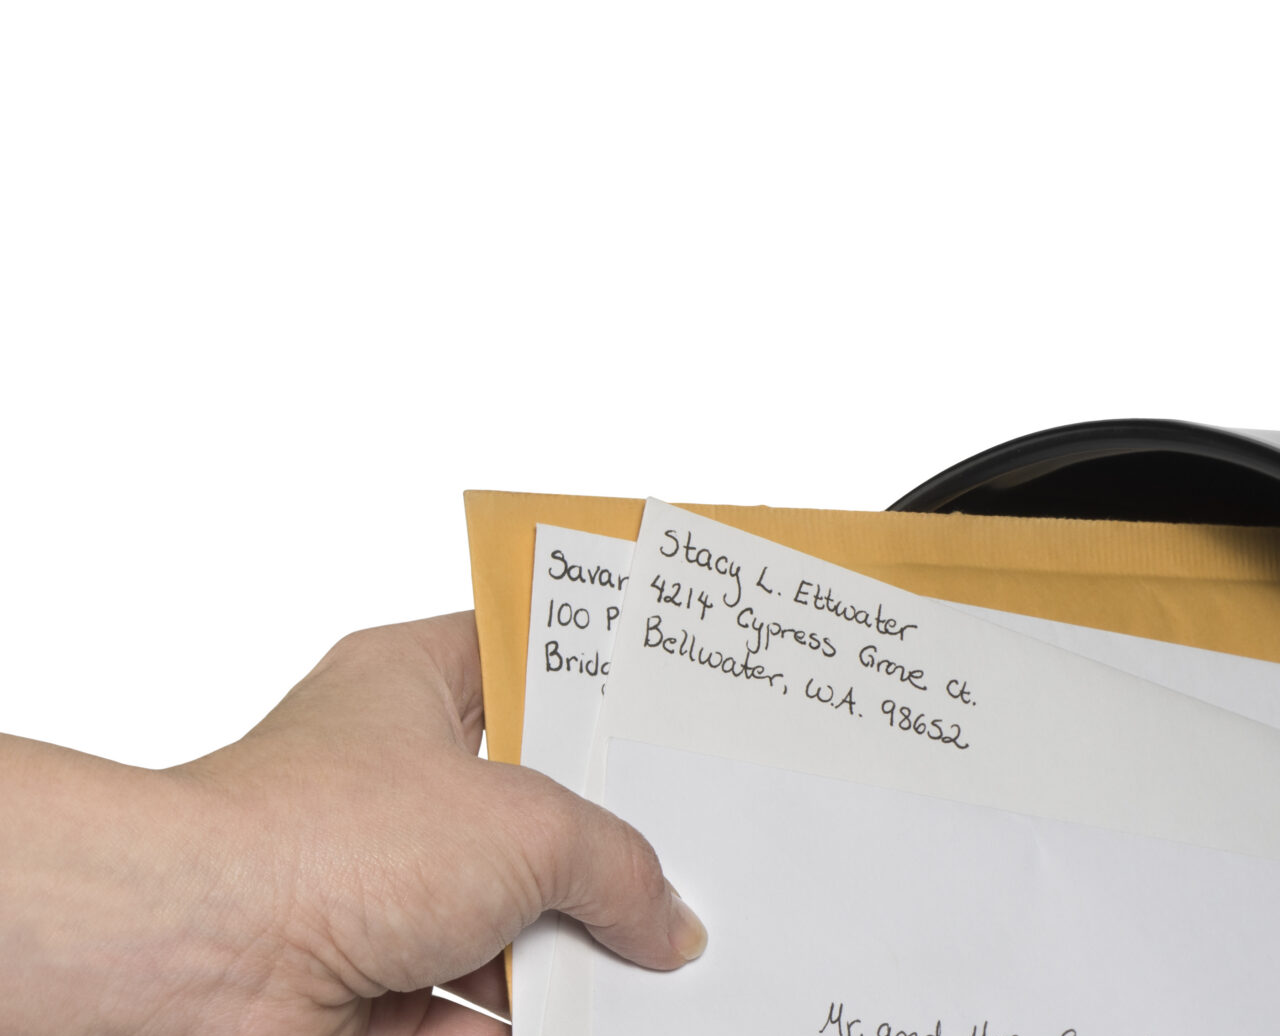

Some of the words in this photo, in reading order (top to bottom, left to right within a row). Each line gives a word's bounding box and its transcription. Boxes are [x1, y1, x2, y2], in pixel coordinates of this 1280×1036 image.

[546, 598, 591, 630] 100
[649, 574, 714, 621] 4214
[736, 607, 838, 658] Cypress
[858, 644, 928, 692] Grove
[659, 529, 743, 608] Stacy
[756, 566, 783, 597] L.
[793, 579, 919, 642] Ettwater
[643, 614, 788, 697] Bellwater,
[804, 677, 864, 718] W.A.
[880, 699, 970, 751] 98652
